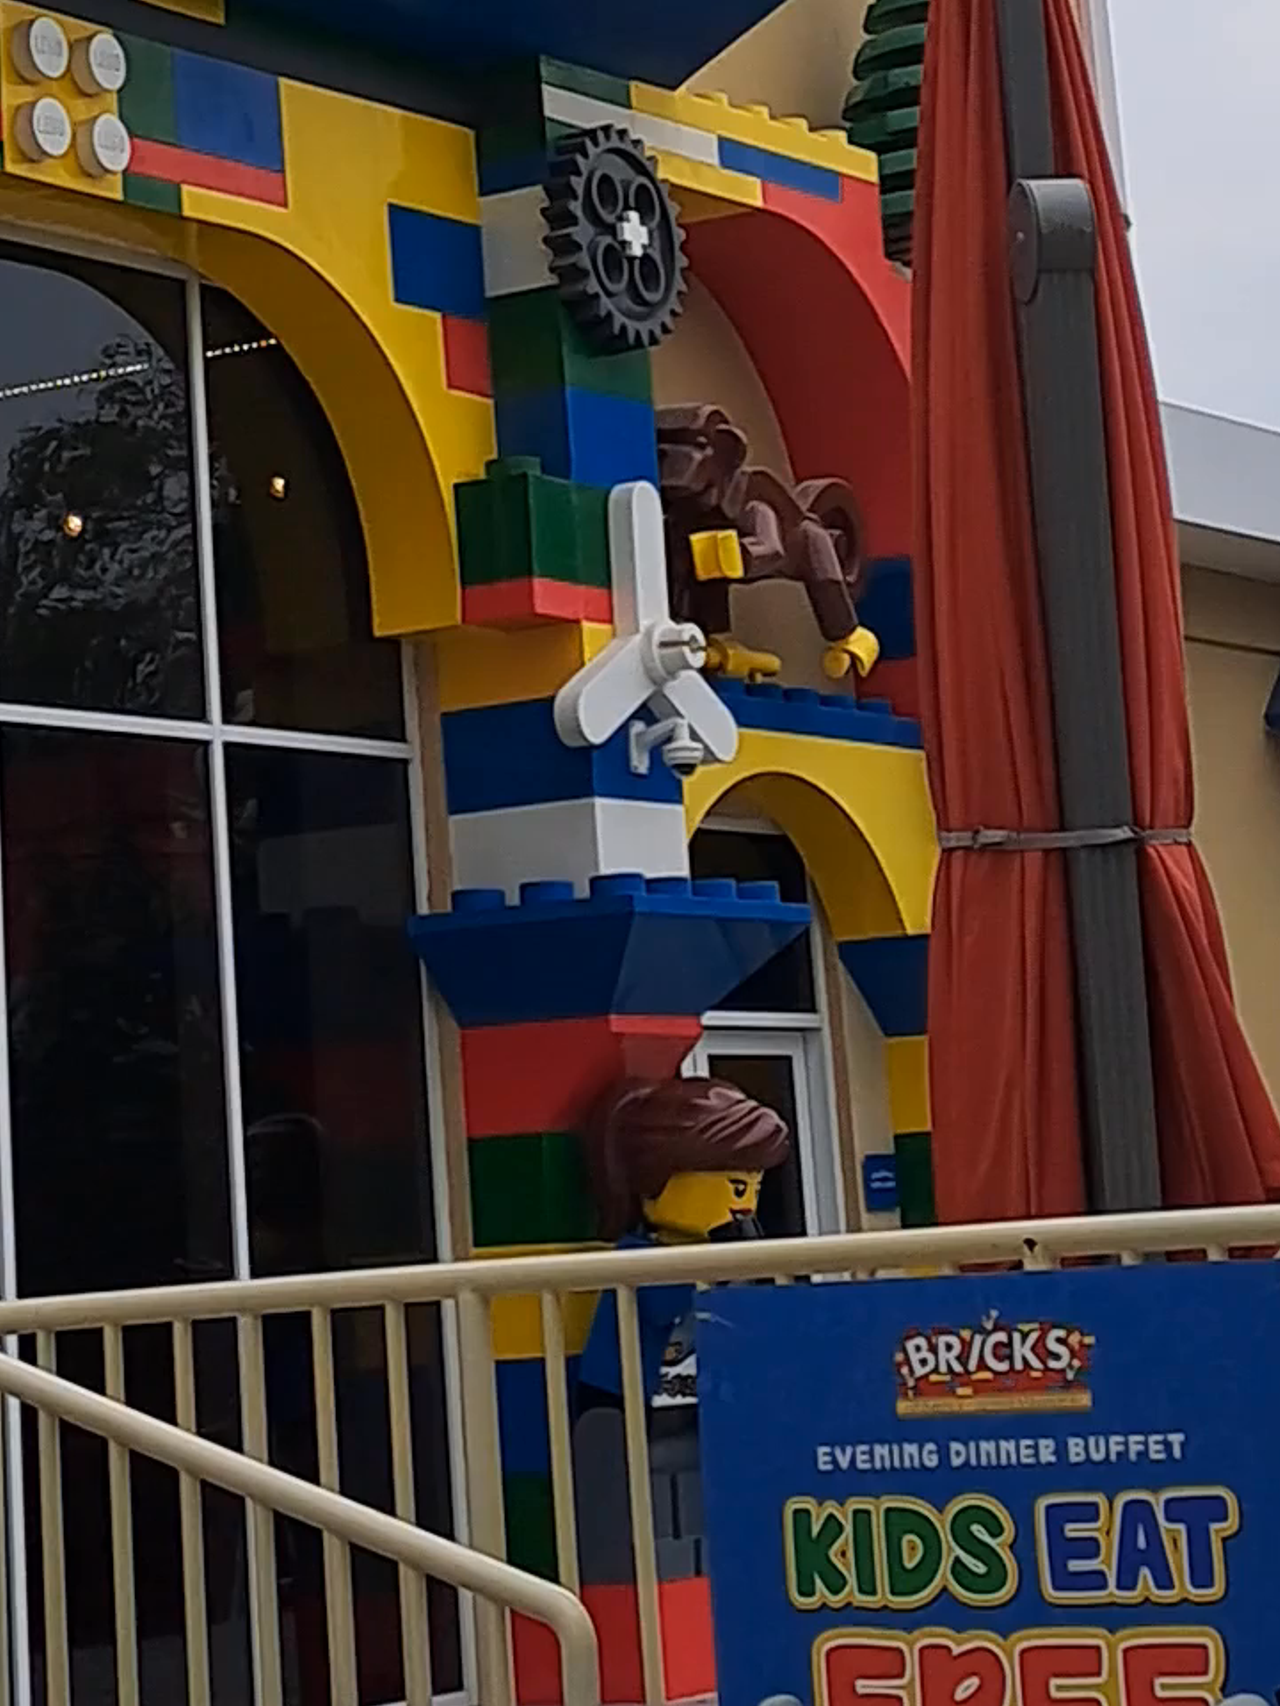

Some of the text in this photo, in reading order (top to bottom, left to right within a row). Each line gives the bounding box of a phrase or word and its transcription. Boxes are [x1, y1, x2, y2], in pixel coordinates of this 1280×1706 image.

[904, 1328, 1071, 1379] BRICKS
[817, 1432, 1186, 1472] EVENING DINNER BUFFET
[787, 1492, 1236, 1606] KIDS EAT
